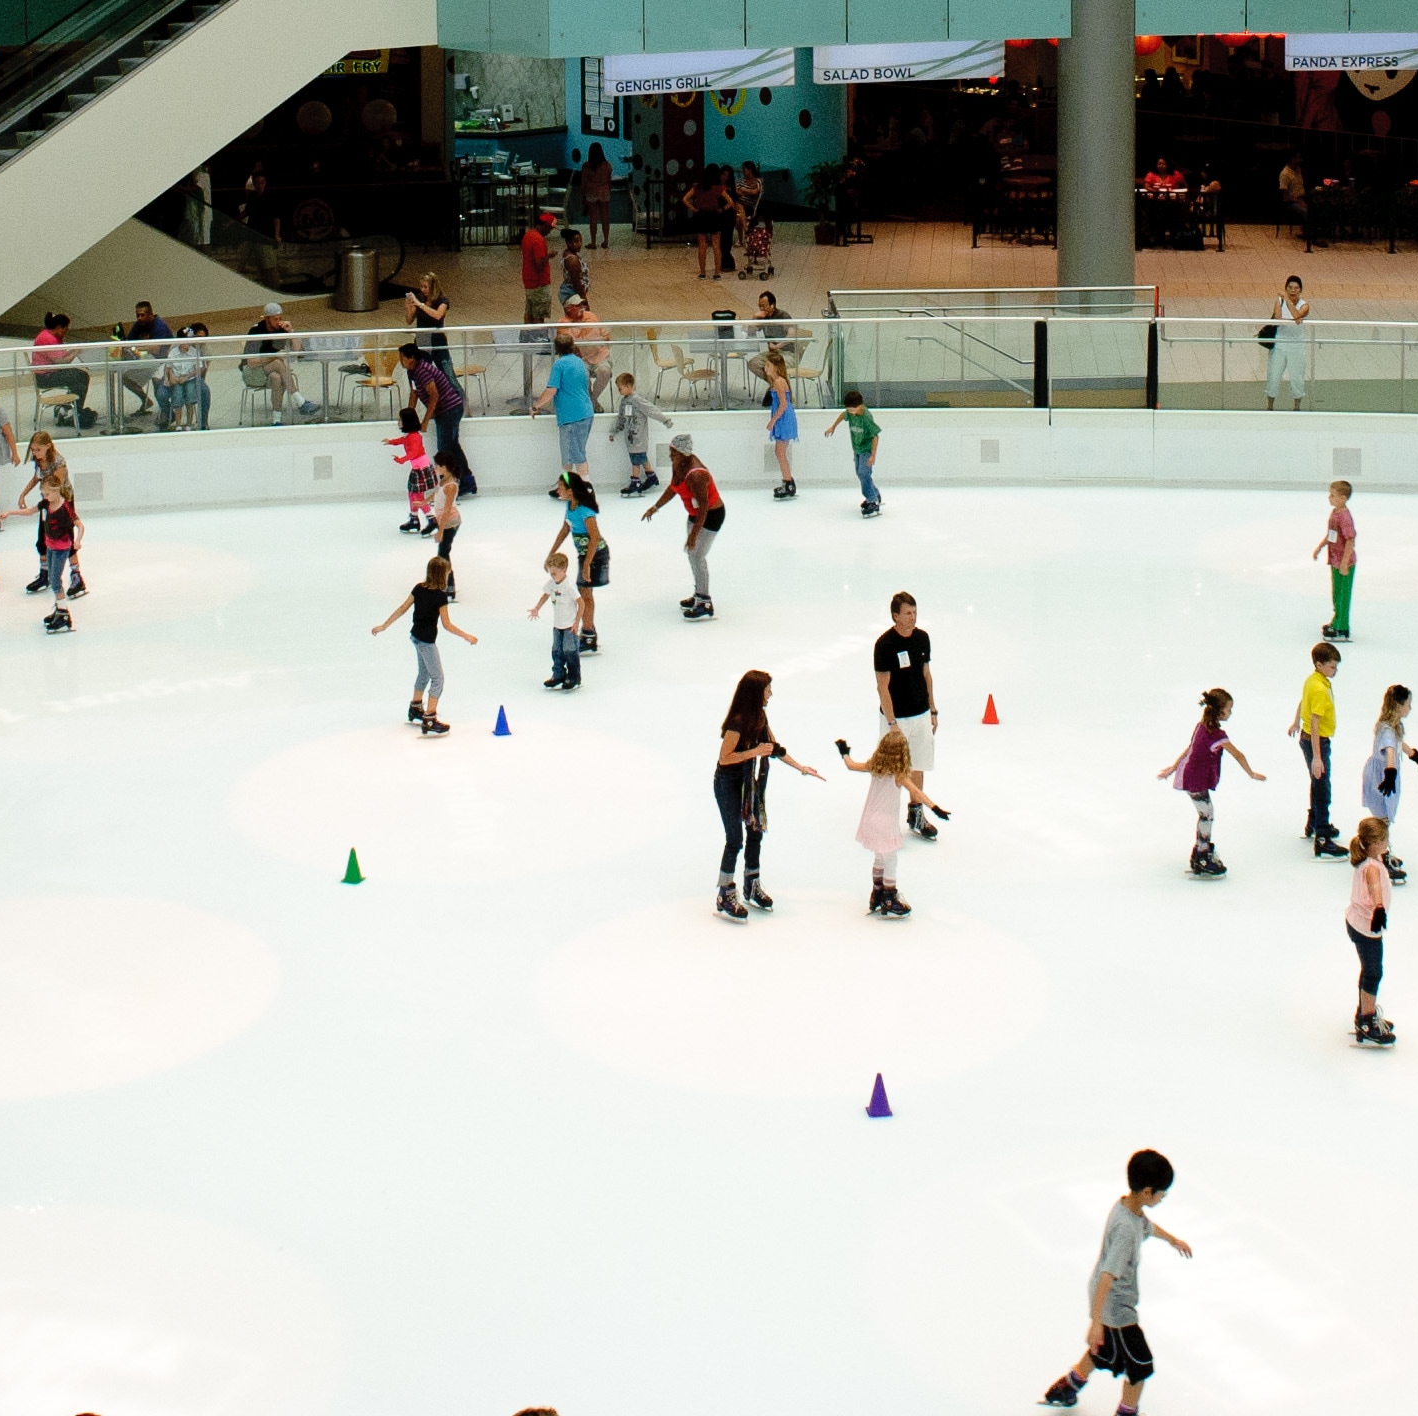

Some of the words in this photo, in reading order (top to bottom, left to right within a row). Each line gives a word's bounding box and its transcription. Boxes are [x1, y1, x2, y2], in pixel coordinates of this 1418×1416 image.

[353, 61, 381, 73] FRY
[1293, 57, 1338, 69] PANDA
[1342, 56, 1399, 67] EXPRESS
[823, 68, 870, 82] SALAD
[874, 67, 915, 79] BOWL
[615, 78, 672, 93] GENGHIS
[676, 76, 712, 89] GRILL
